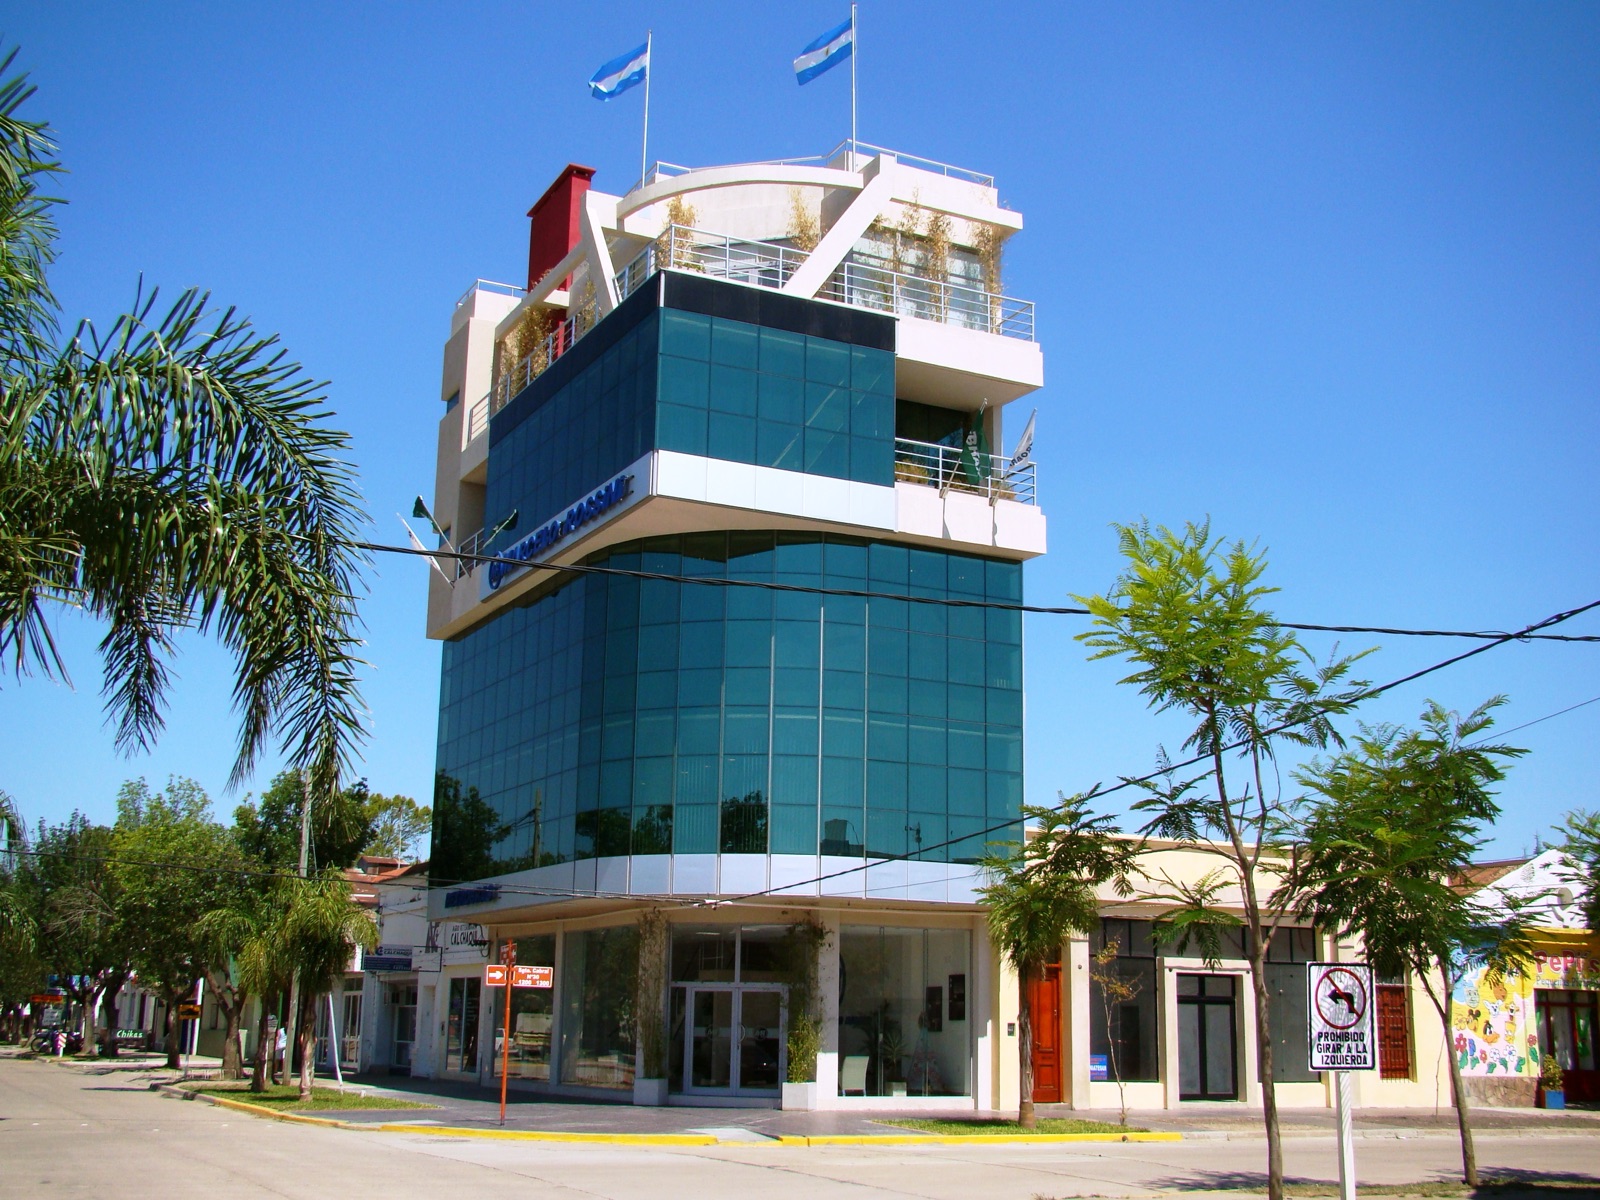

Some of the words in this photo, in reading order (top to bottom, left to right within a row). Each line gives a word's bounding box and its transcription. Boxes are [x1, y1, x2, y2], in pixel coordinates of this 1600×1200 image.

[116, 1030, 143, 1038] Chikas
[1317, 1032, 1364, 1042] PROHIBIDO
[1317, 1043, 1341, 1053] GIRAR
[1346, 1044, 1352, 1053] A
[1356, 1044, 1367, 1053] LA
[1321, 1055, 1367, 1065] IZQUIERDA
